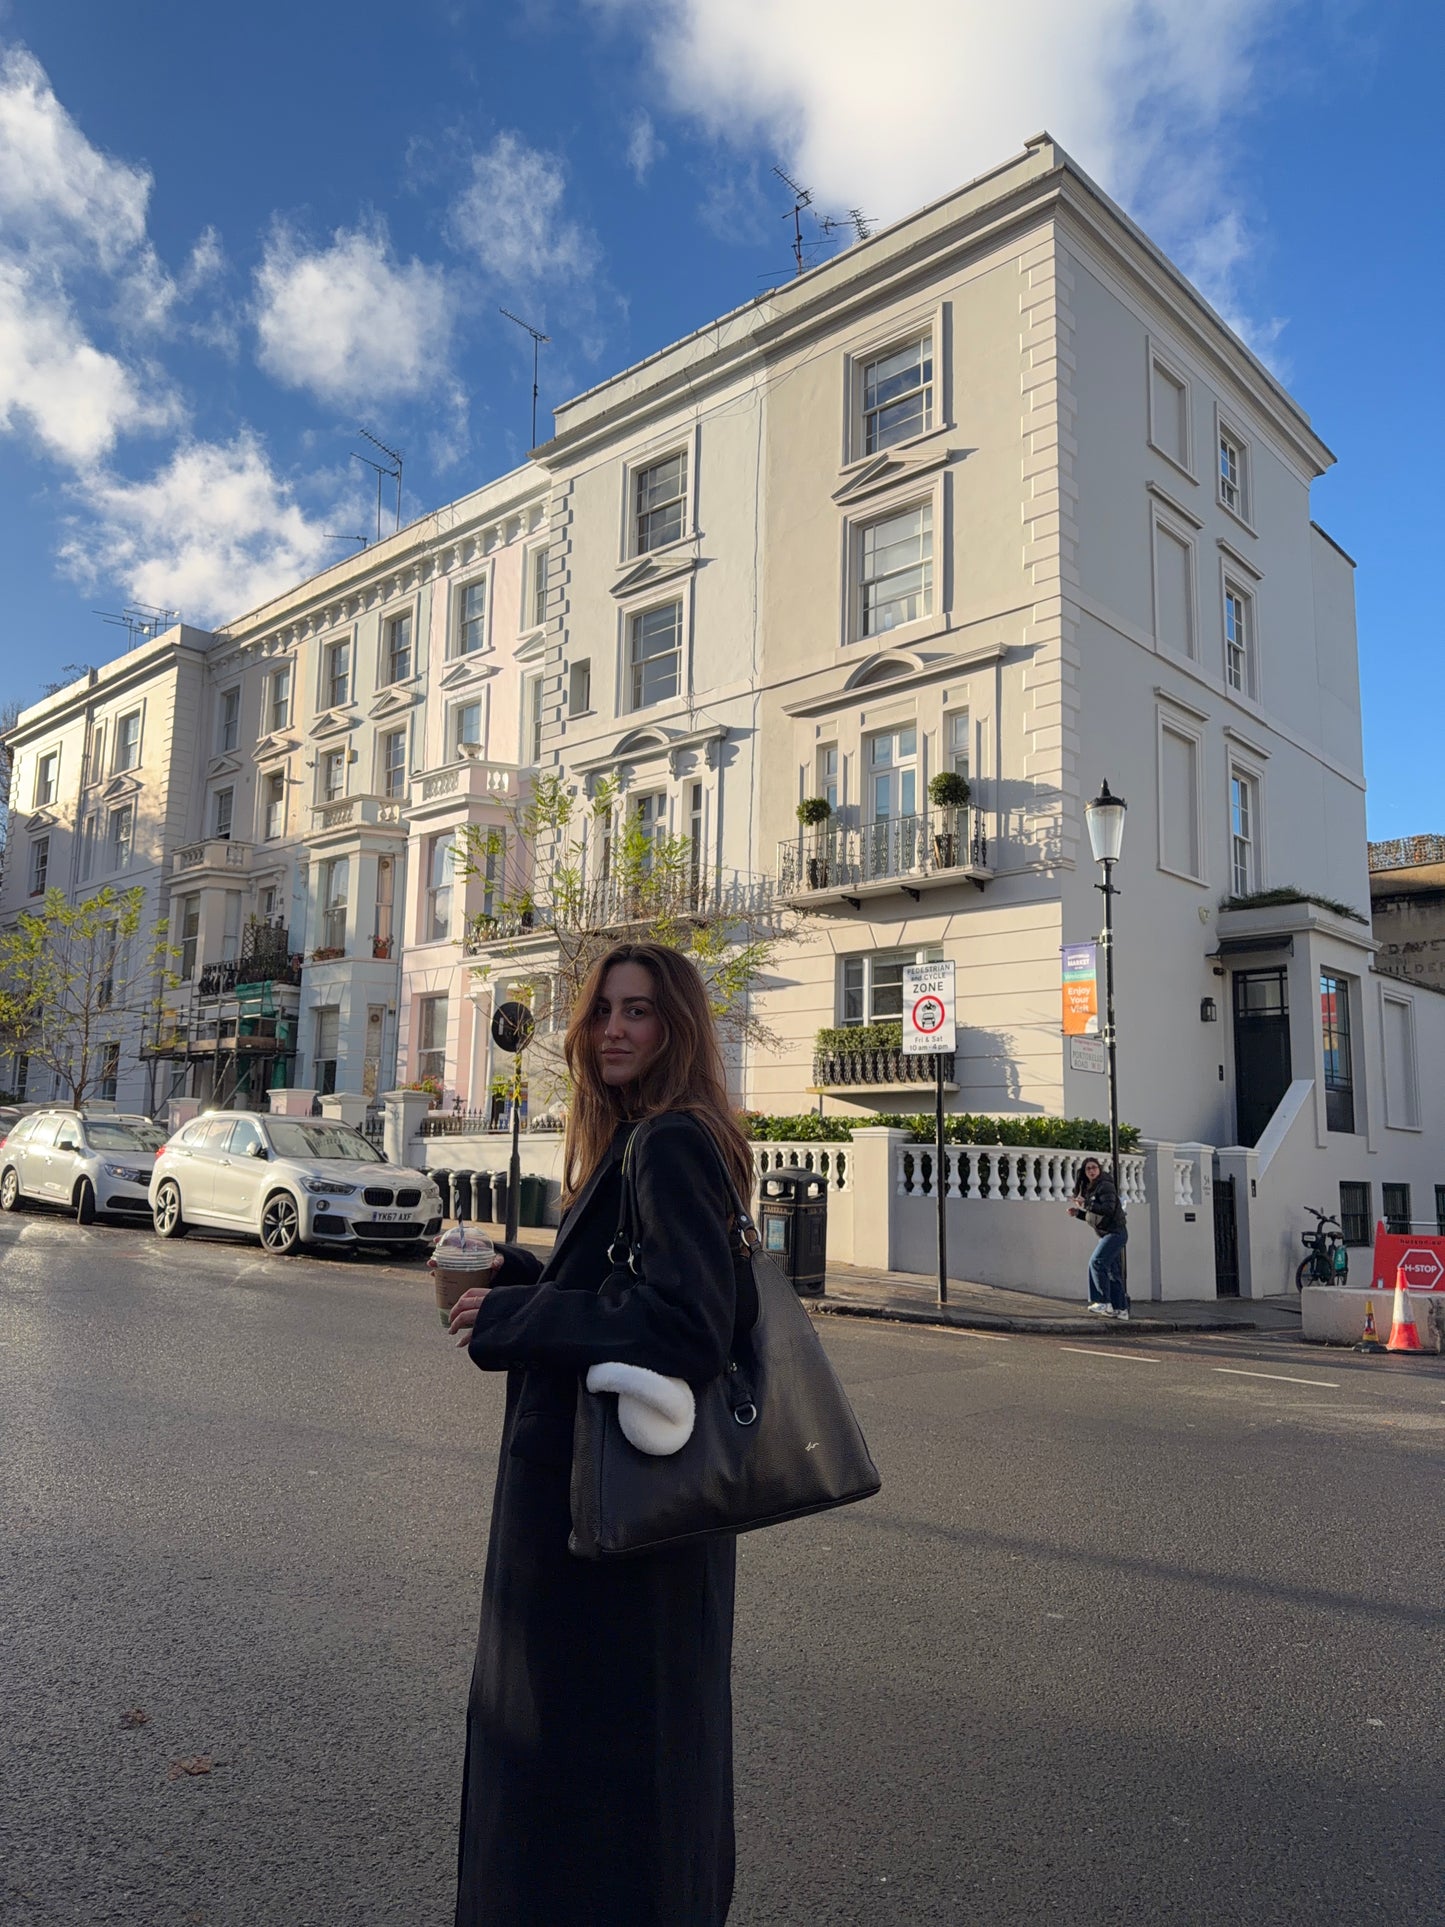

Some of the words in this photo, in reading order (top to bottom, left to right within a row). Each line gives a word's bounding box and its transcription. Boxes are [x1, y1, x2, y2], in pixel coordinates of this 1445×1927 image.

[907, 963, 951, 975] PEDESTRIAN
[924, 972, 946, 981] CYCLE
[913, 981, 944, 994] ZONE
[1067, 987, 1091, 996] Enjoy
[1070, 996, 1089, 1004] Your
[1070, 1005, 1089, 1014] Visit
[378, 1212, 397, 1221] YK67
[398, 1212, 412, 1221] AXF
[1404, 1263, 1437, 1274] H-STOP
